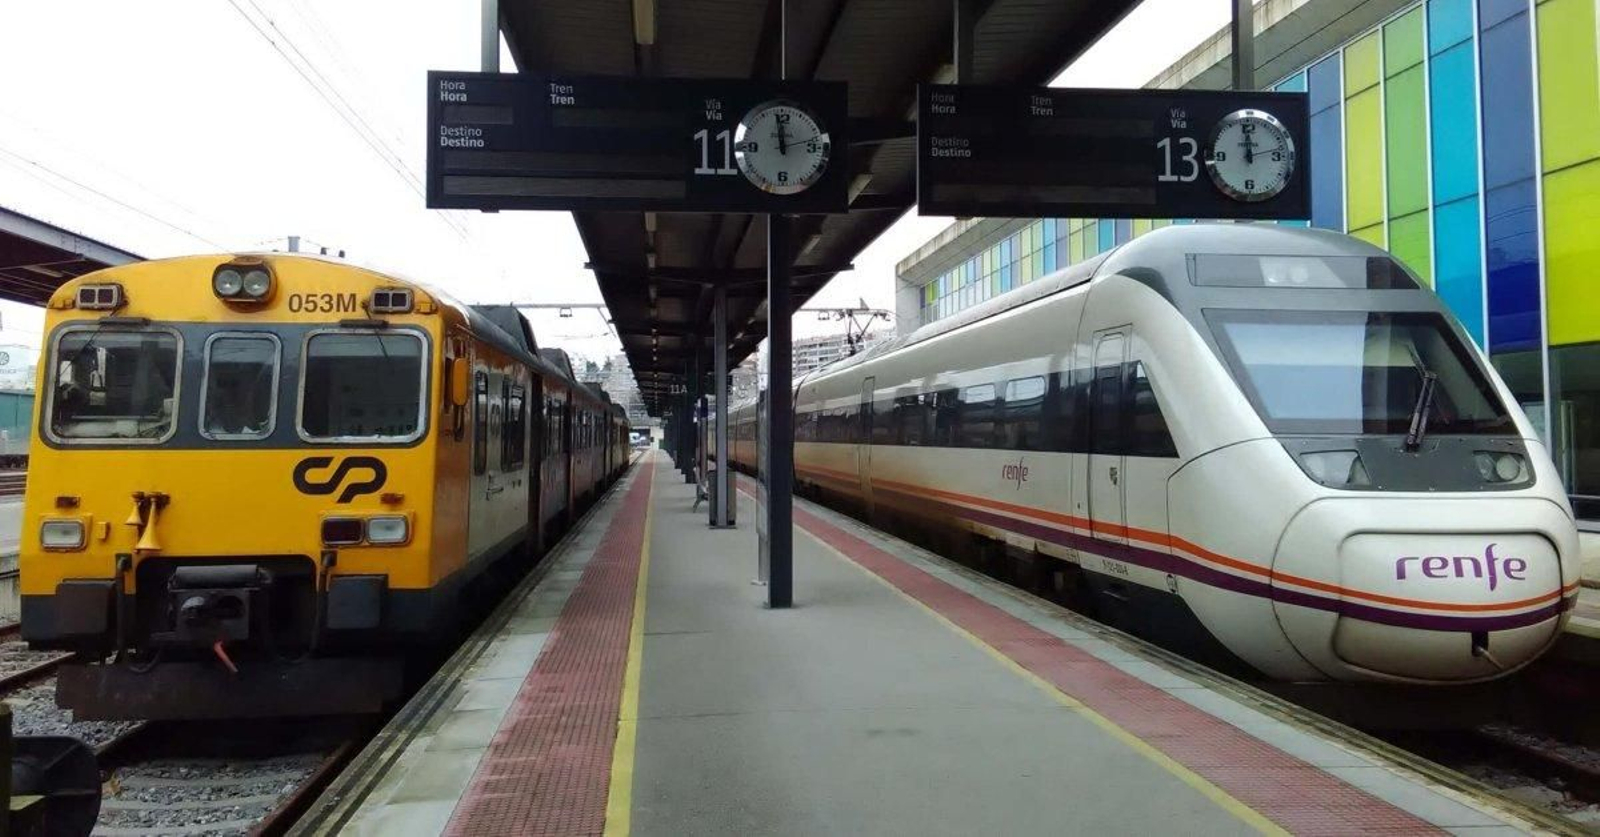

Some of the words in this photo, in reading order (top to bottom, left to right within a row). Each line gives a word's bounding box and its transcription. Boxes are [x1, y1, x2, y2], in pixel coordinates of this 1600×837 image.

[440, 80, 466, 90] Hora
[549, 83, 573, 94] Tren
[440, 91, 468, 102] Hora
[549, 94, 575, 105] Tren
[931, 92, 955, 103] Hora
[1031, 95, 1052, 106] Tren
[931, 103, 956, 114] Hora
[1031, 106, 1053, 116] Tren
[440, 125, 483, 137] Destino
[440, 136, 485, 148] Destino
[931, 136, 970, 147] Destino
[694, 128, 738, 175] 11
[748, 142, 758, 153] 9
[807, 142, 817, 154] 3
[931, 147, 972, 158] Destino
[1156, 136, 1200, 182] 13
[1216, 151, 1226, 162] 9
[1271, 151, 1281, 162] 3
[777, 171, 789, 182] 6
[1245, 180, 1255, 190] 6
[288, 292, 357, 313] 053M
[670, 384, 688, 394] 11A
[1002, 456, 1029, 491] renfe
[1396, 543, 1527, 592] renfe
